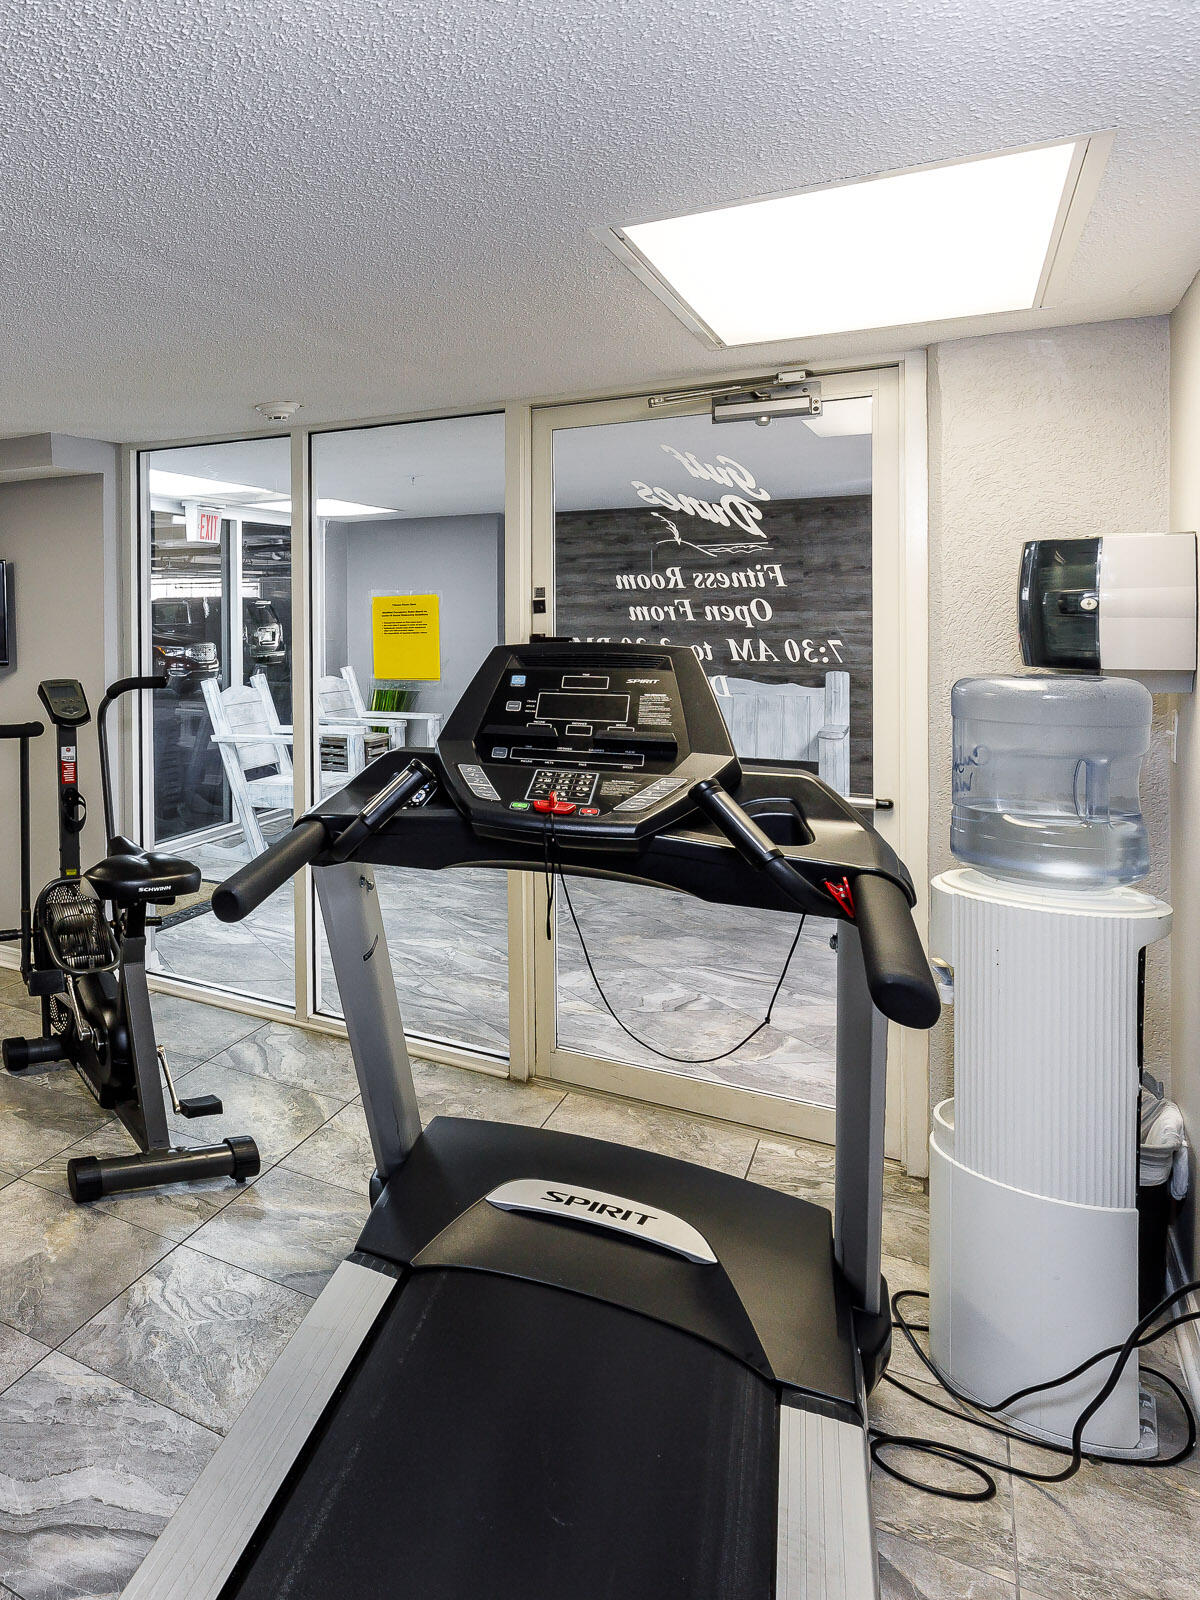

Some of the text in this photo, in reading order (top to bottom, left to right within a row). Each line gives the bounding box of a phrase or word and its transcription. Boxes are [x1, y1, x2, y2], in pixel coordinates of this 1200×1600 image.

[200, 513, 219, 541] EXIT
[138, 884, 172, 892] SCHWINN
[540, 1190, 658, 1226] SPIRIT
